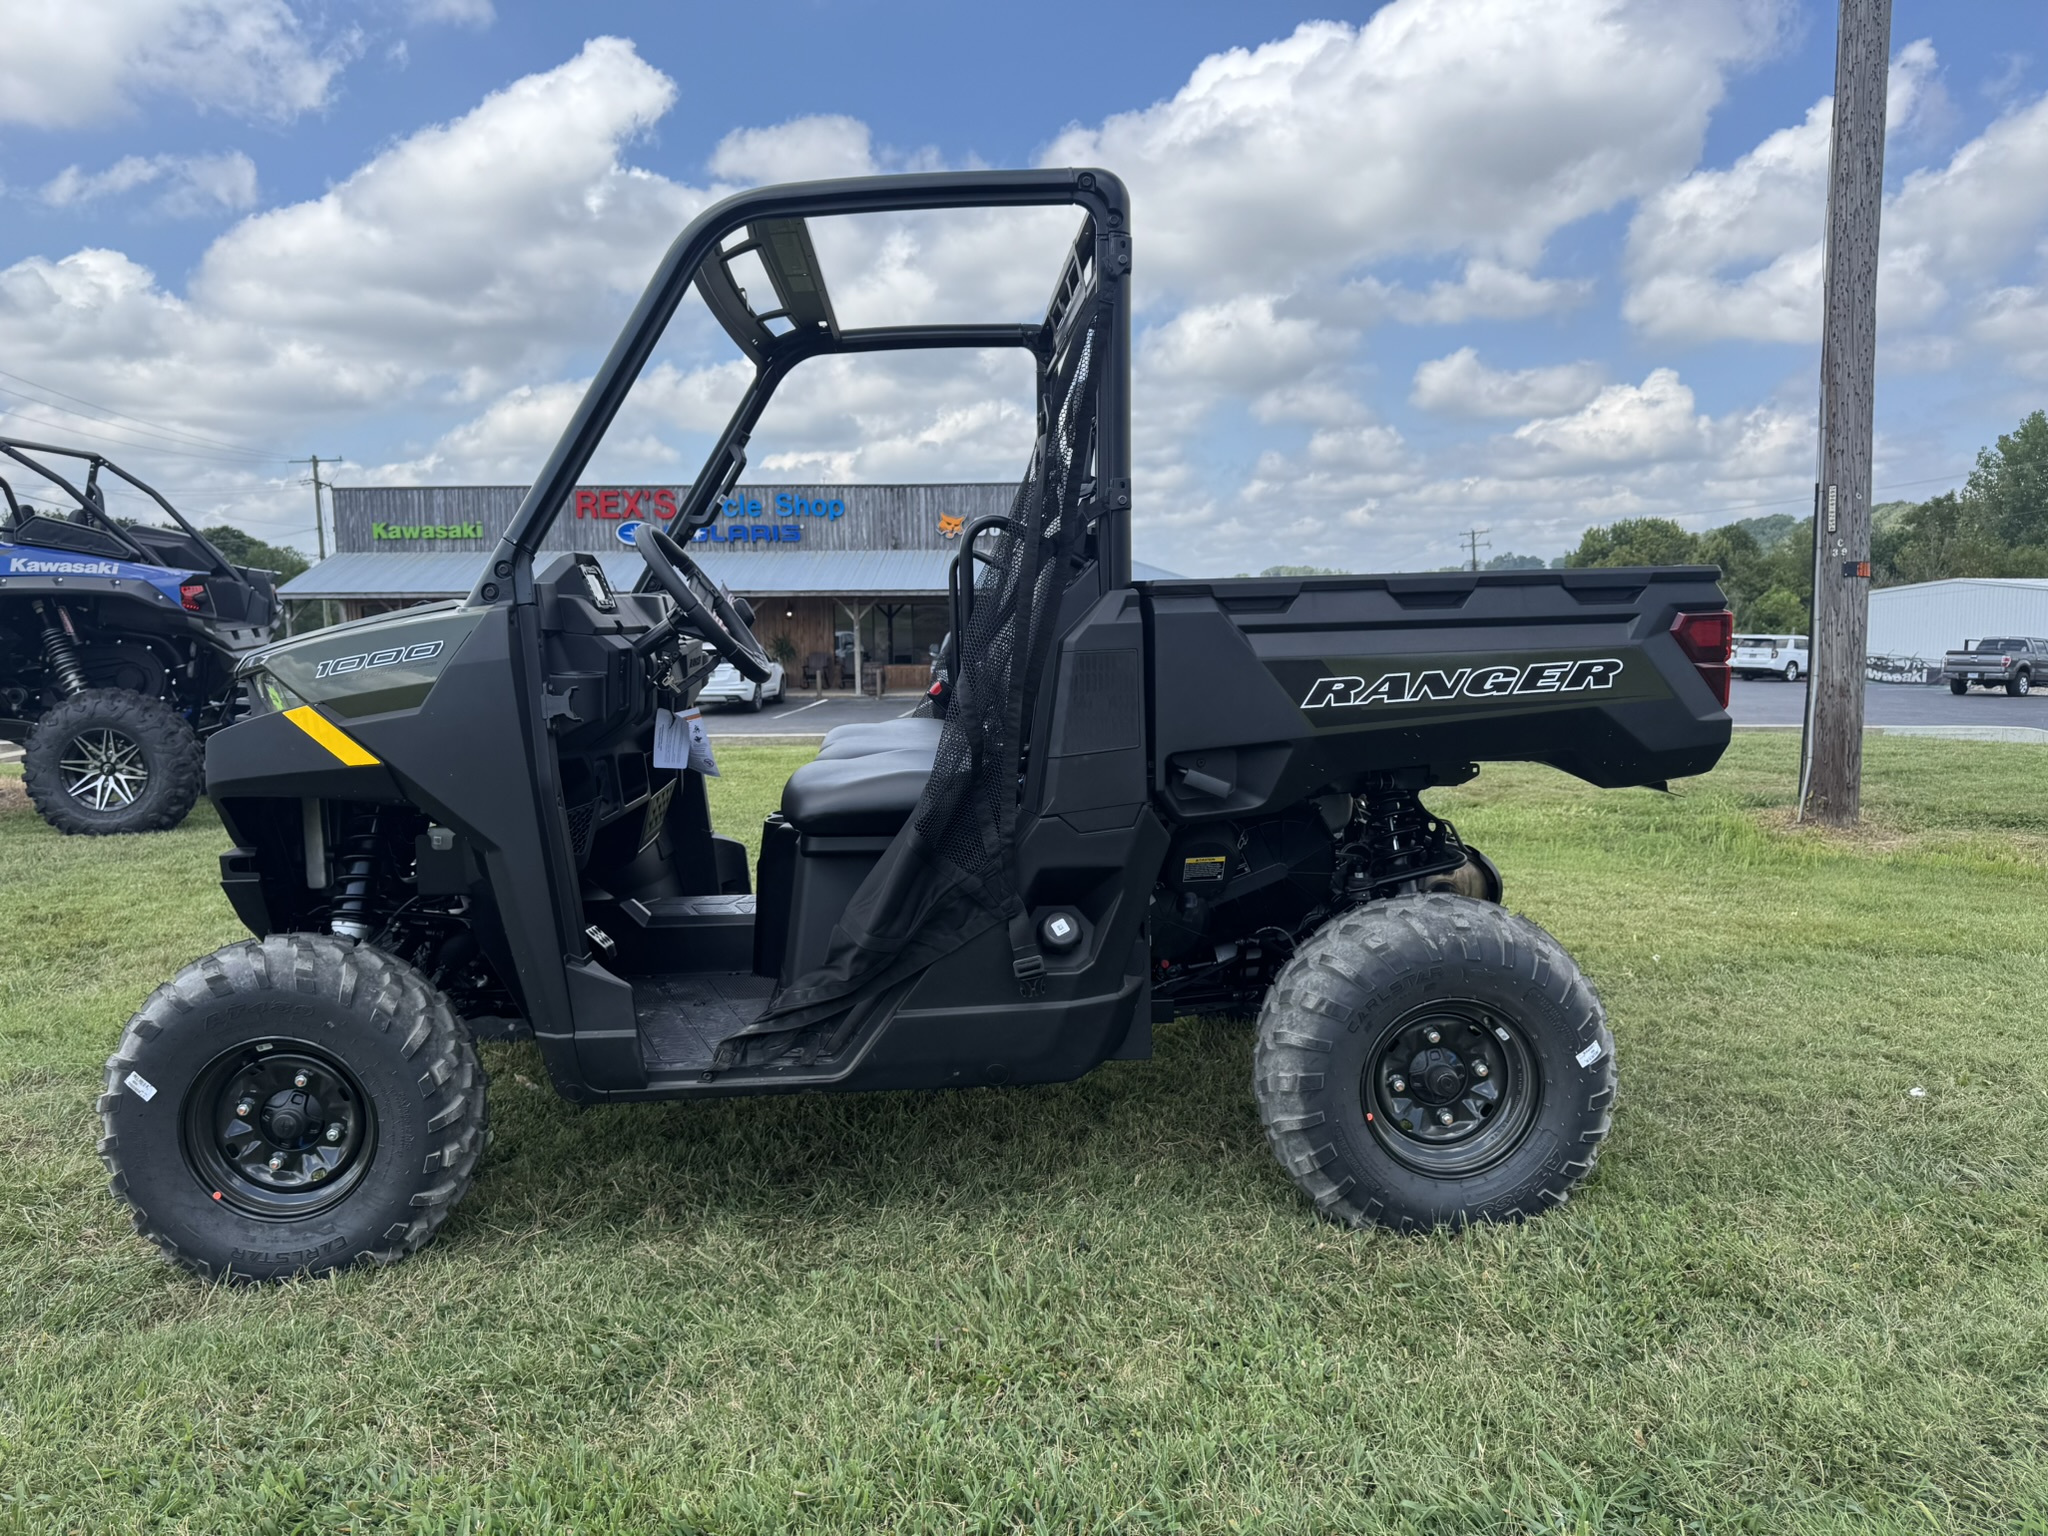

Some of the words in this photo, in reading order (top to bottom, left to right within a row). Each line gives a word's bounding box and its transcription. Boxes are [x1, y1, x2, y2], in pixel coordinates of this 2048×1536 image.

[575, 489, 677, 519] REX'S
[722, 494, 761, 517] cle
[775, 493, 845, 521] Shop
[372, 520, 484, 540] Kawasaki
[663, 524, 802, 543] OLARIS
[9, 558, 119, 574] Kawasaki
[315, 640, 444, 678] 1000
[1301, 658, 1625, 709] RANGER
[1866, 667, 1928, 683] wasaki
[1346, 965, 1443, 1034] CARLSTAR
